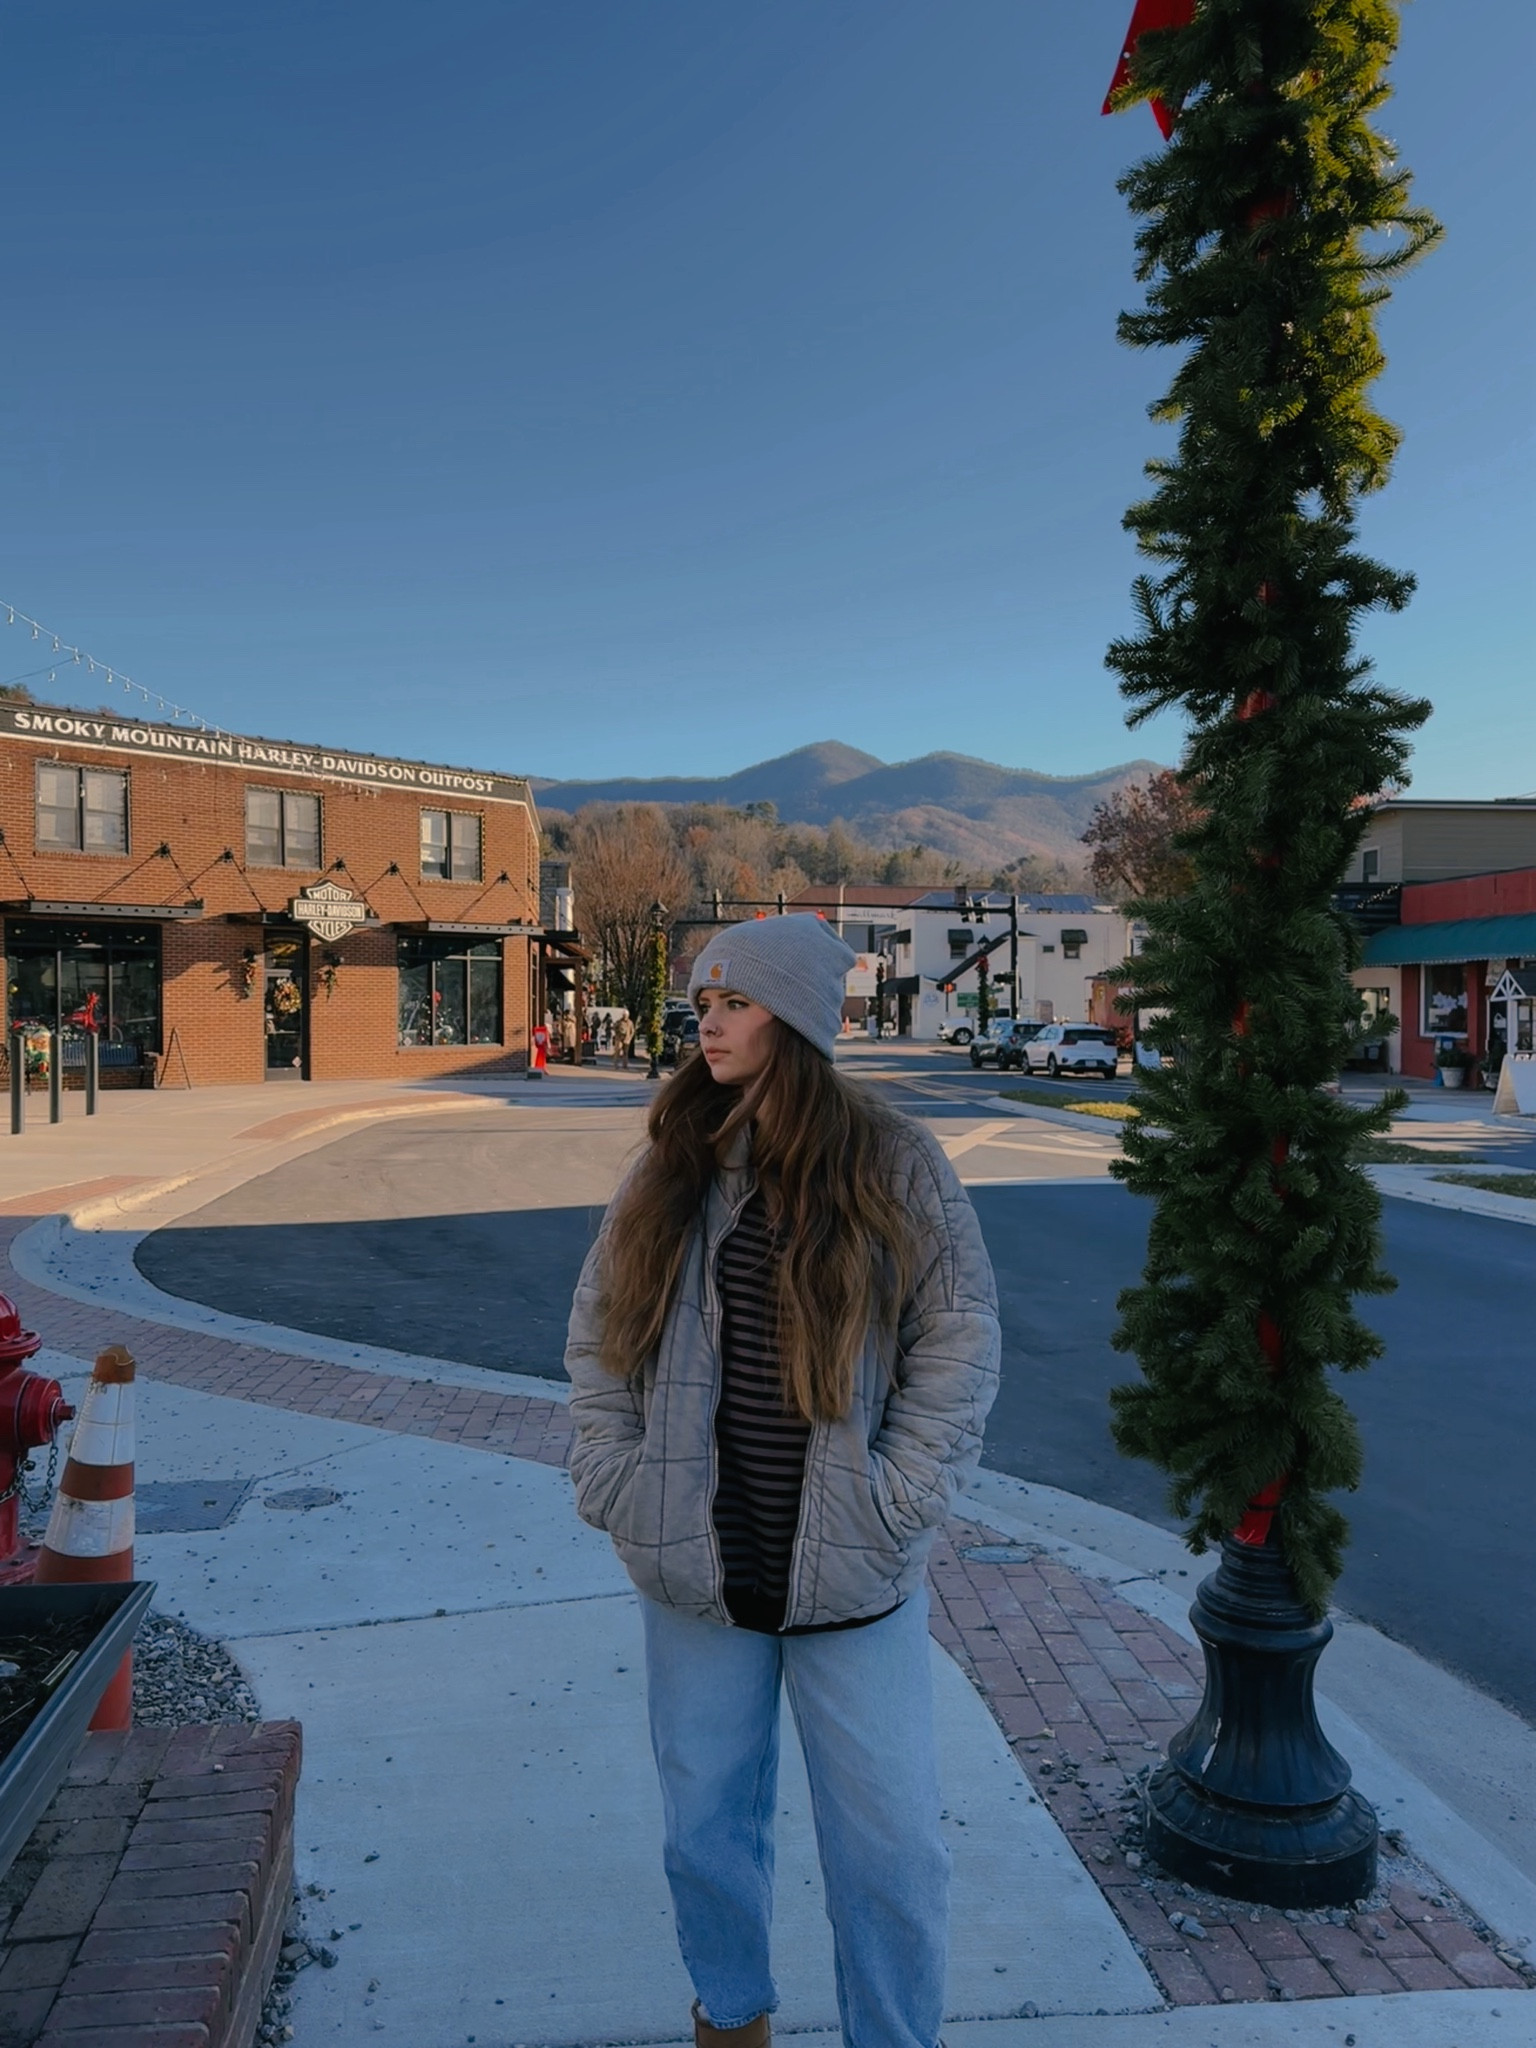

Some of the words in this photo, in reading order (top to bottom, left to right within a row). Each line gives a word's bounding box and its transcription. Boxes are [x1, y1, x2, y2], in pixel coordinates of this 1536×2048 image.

[14, 713, 106, 738] SMOKY
[111, 726, 233, 756] MOUNTAIN
[238, 744, 416, 781] HARLEY-DAVIDSON
[419, 770, 494, 792] OUTPOST
[313, 887, 347, 901] MOTOR
[297, 902, 361, 918] HARLEY-DAVIDSON
[313, 920, 347, 937] CYCLES
